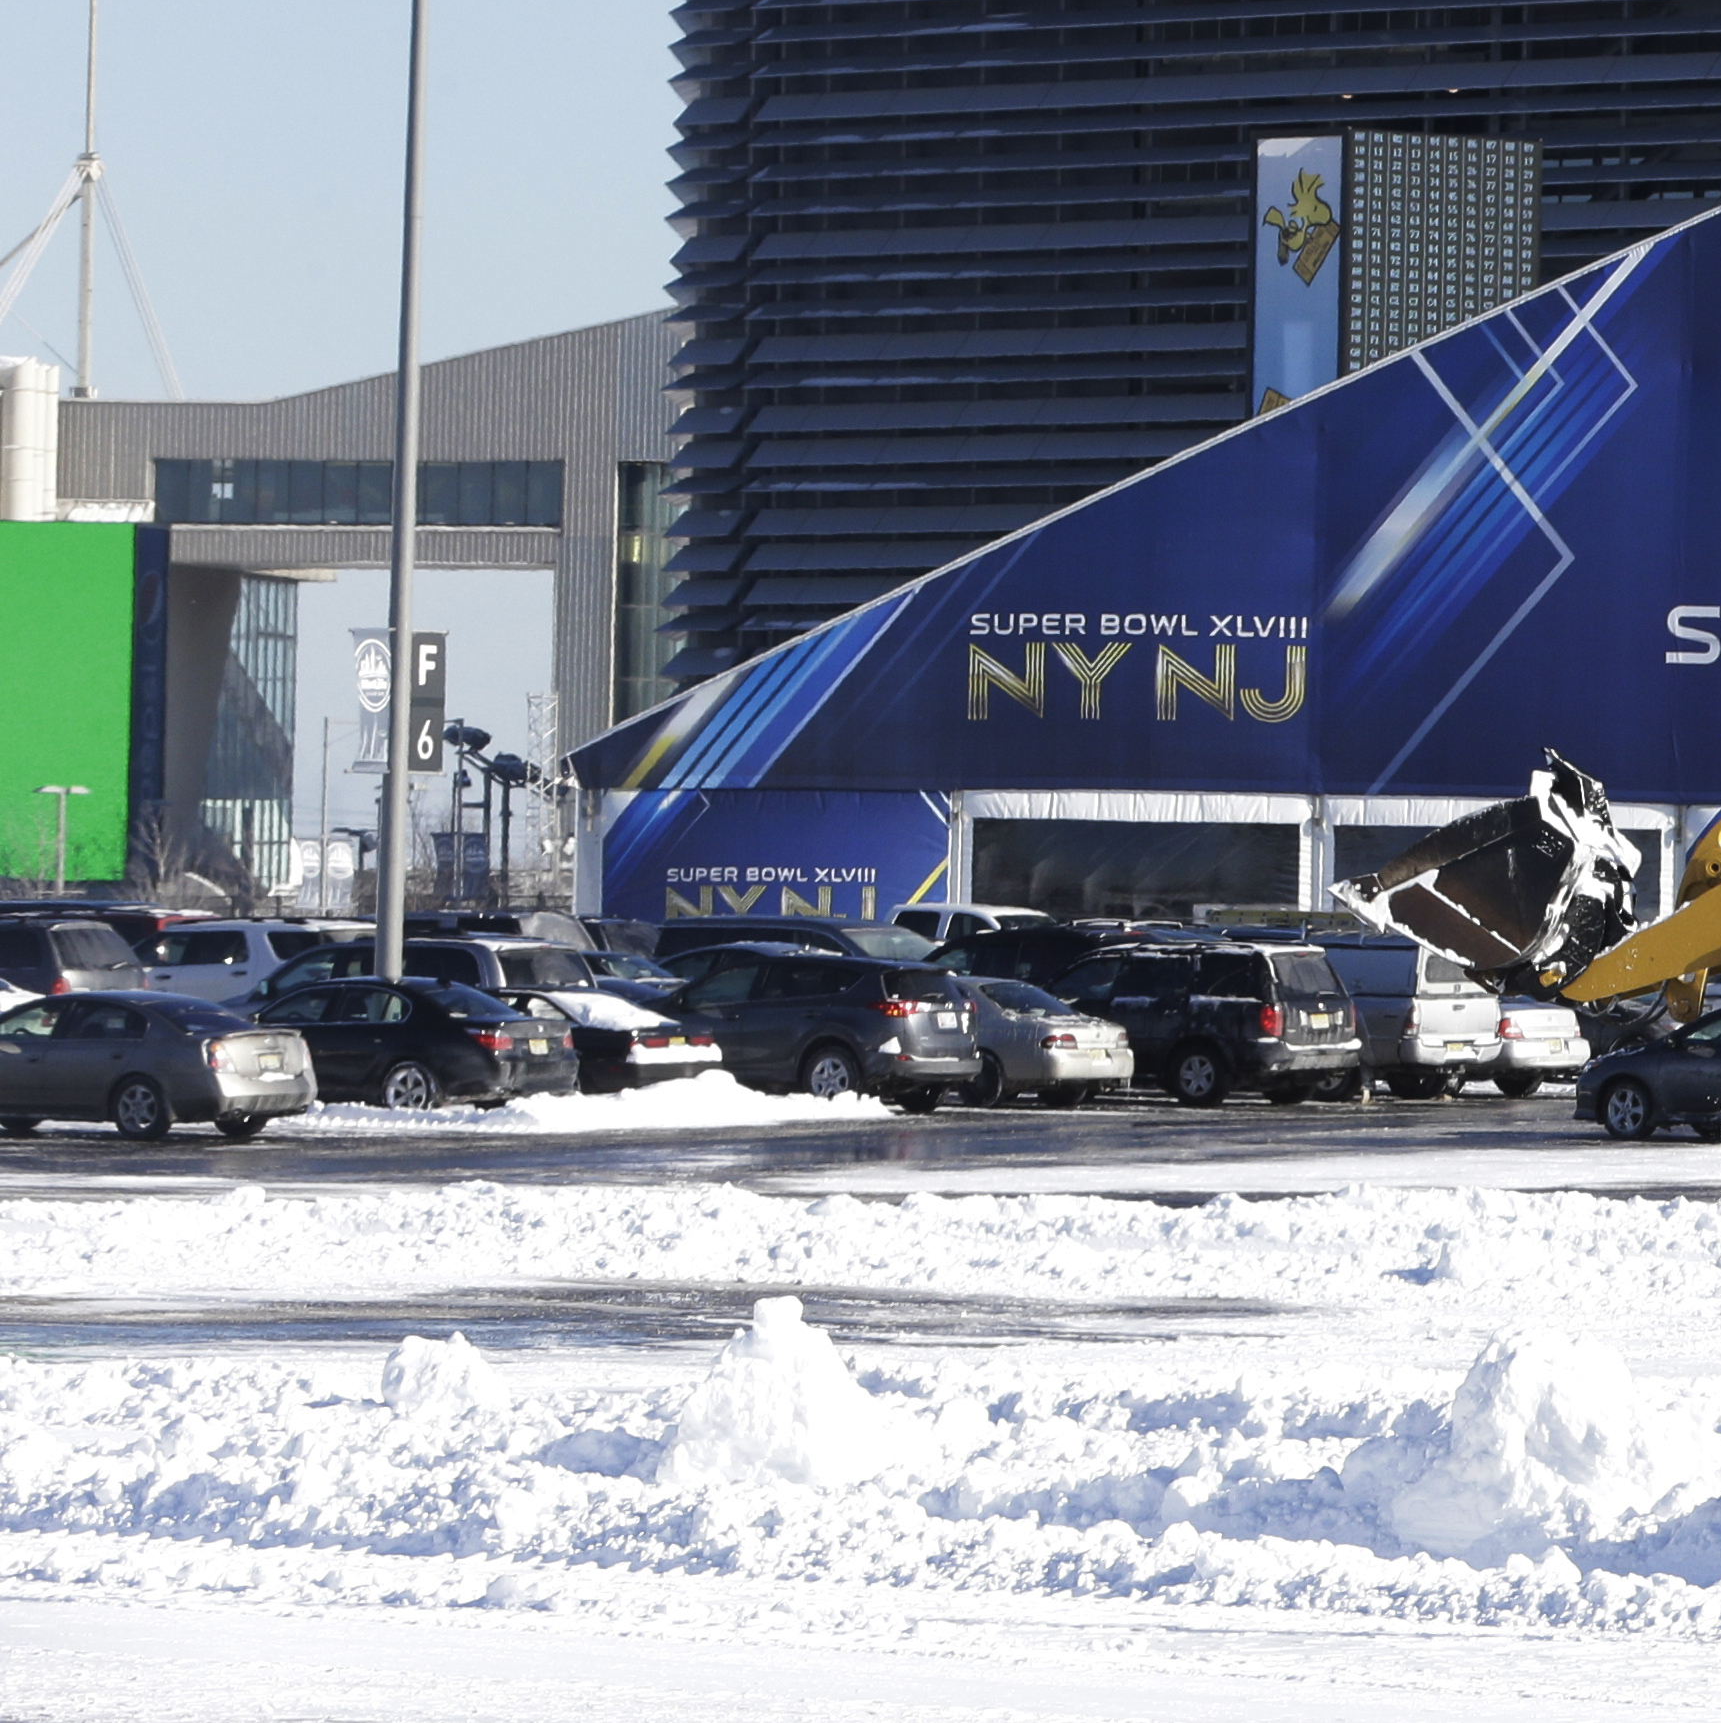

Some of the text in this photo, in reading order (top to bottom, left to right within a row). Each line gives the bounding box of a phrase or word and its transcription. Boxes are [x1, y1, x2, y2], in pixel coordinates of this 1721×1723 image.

[970, 613, 1307, 638] SUPER BOWL XLVIII
[419, 644, 438, 686] F
[968, 641, 1306, 723] NY NJ
[417, 720, 434, 760] 6
[667, 867, 876, 883] SUPER BOWL XLVIII
